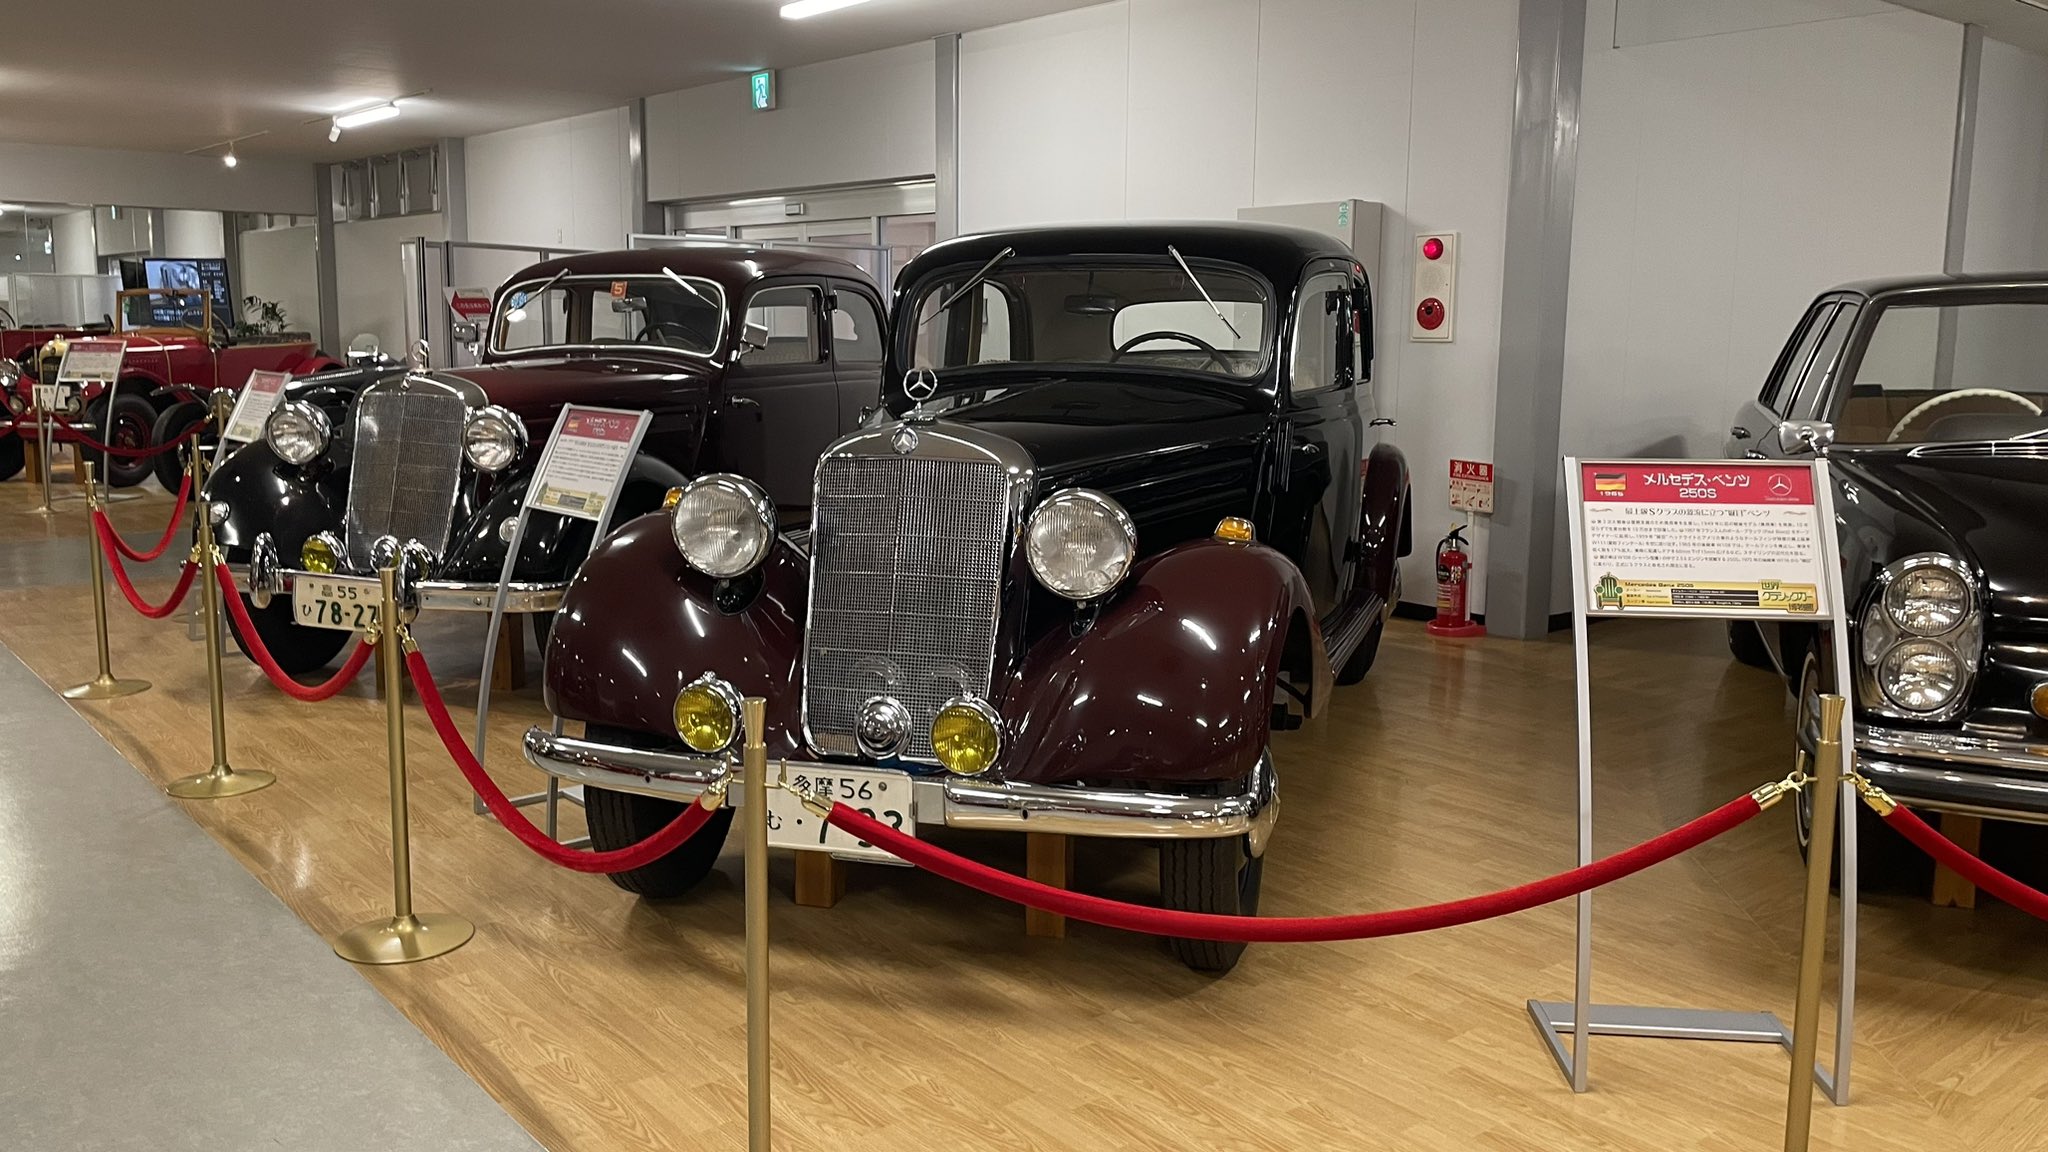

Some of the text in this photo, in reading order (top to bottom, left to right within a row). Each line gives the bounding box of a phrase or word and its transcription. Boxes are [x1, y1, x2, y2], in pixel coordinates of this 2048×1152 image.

[614, 283, 624, 295] 5
[1643, 474, 1750, 487] メルセデス・ベンツ
[1679, 488, 1717, 498] 250S
[337, 586, 357, 600] 55
[315, 599, 377, 628] 78-27
[793, 774, 873, 800] 多摩 56
